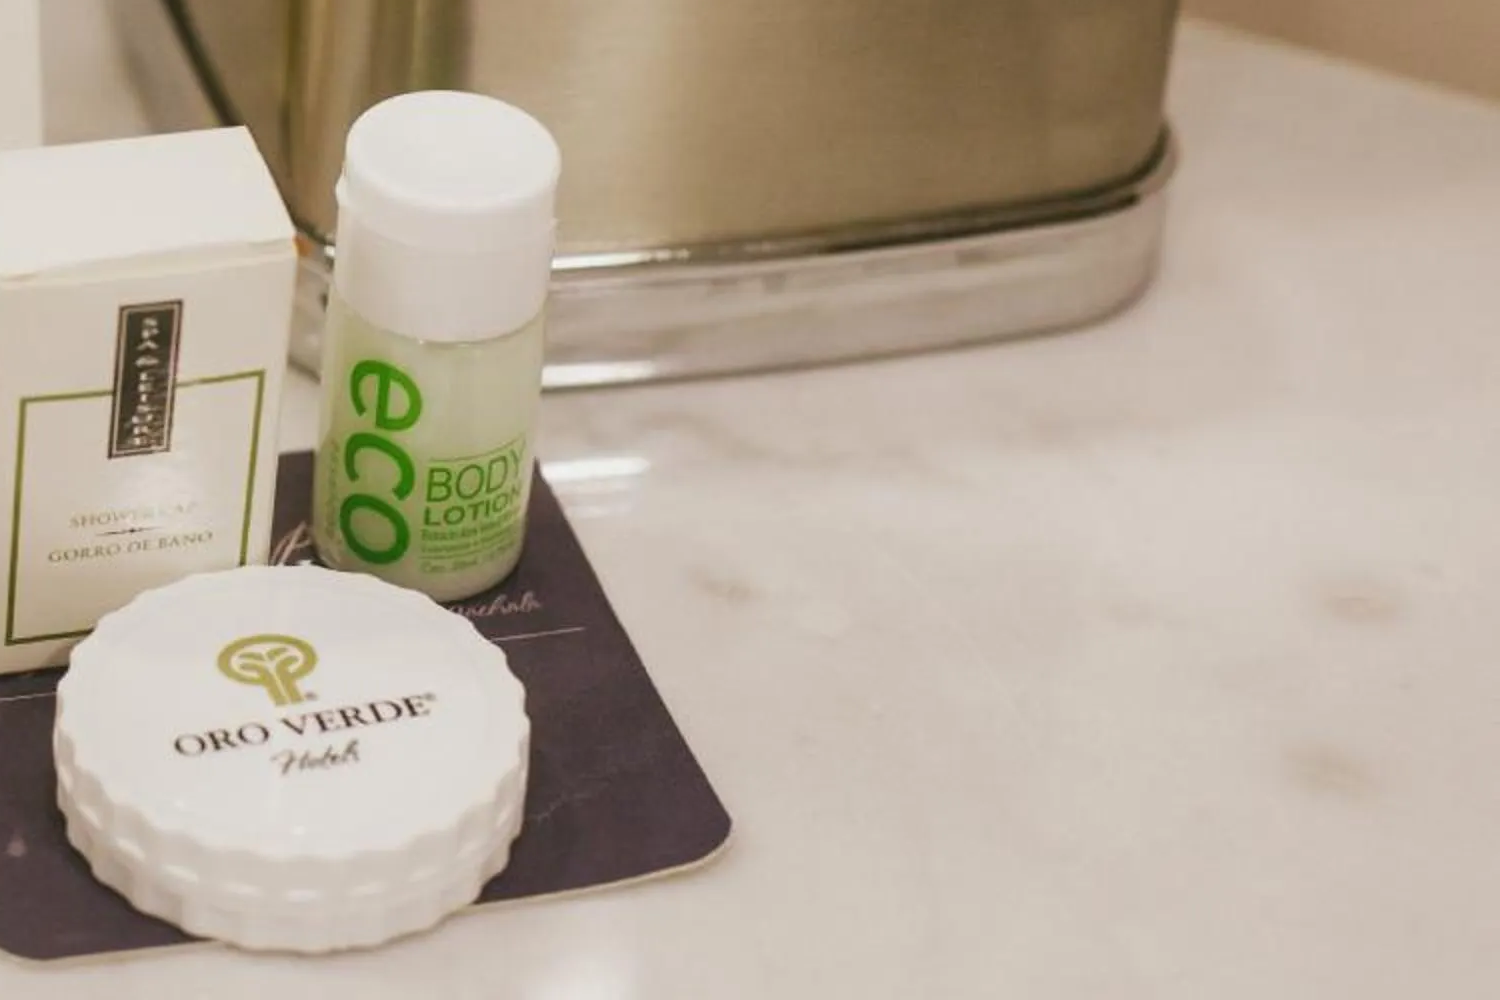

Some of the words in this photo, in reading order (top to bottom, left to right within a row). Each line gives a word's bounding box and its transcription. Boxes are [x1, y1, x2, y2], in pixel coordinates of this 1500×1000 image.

[340, 360, 423, 565] eco
[426, 448, 522, 503] BODY
[48, 543, 121, 563] GORRO
[127, 539, 151, 553] DE
[174, 722, 270, 757] ORO
